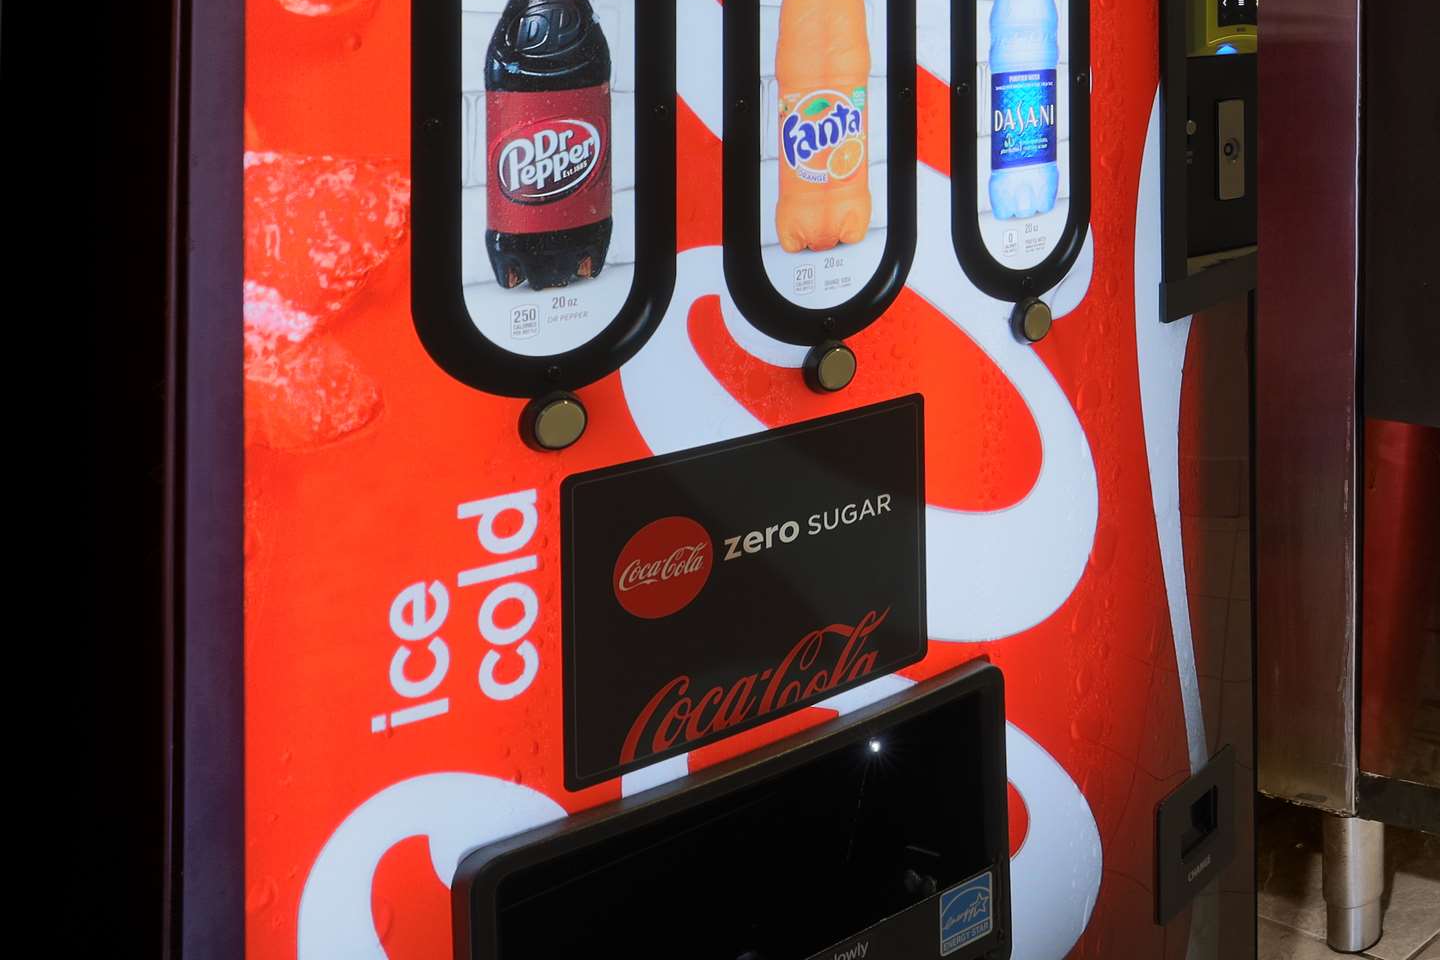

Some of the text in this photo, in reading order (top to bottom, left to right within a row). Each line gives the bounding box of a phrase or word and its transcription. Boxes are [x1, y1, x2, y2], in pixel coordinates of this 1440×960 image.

[994, 102, 1054, 136] DASANI
[534, 129, 573, 161] Dr
[500, 138, 597, 192] Pepper
[796, 268, 813, 281] 270
[824, 257, 834, 269] 20
[514, 308, 537, 323] 250
[552, 296, 566, 309] 20
[723, 493, 891, 561] zero SUGAR
[618, 542, 707, 591] Coca-Cola
[457, 488, 540, 702] cold
[371, 579, 450, 734] ice
